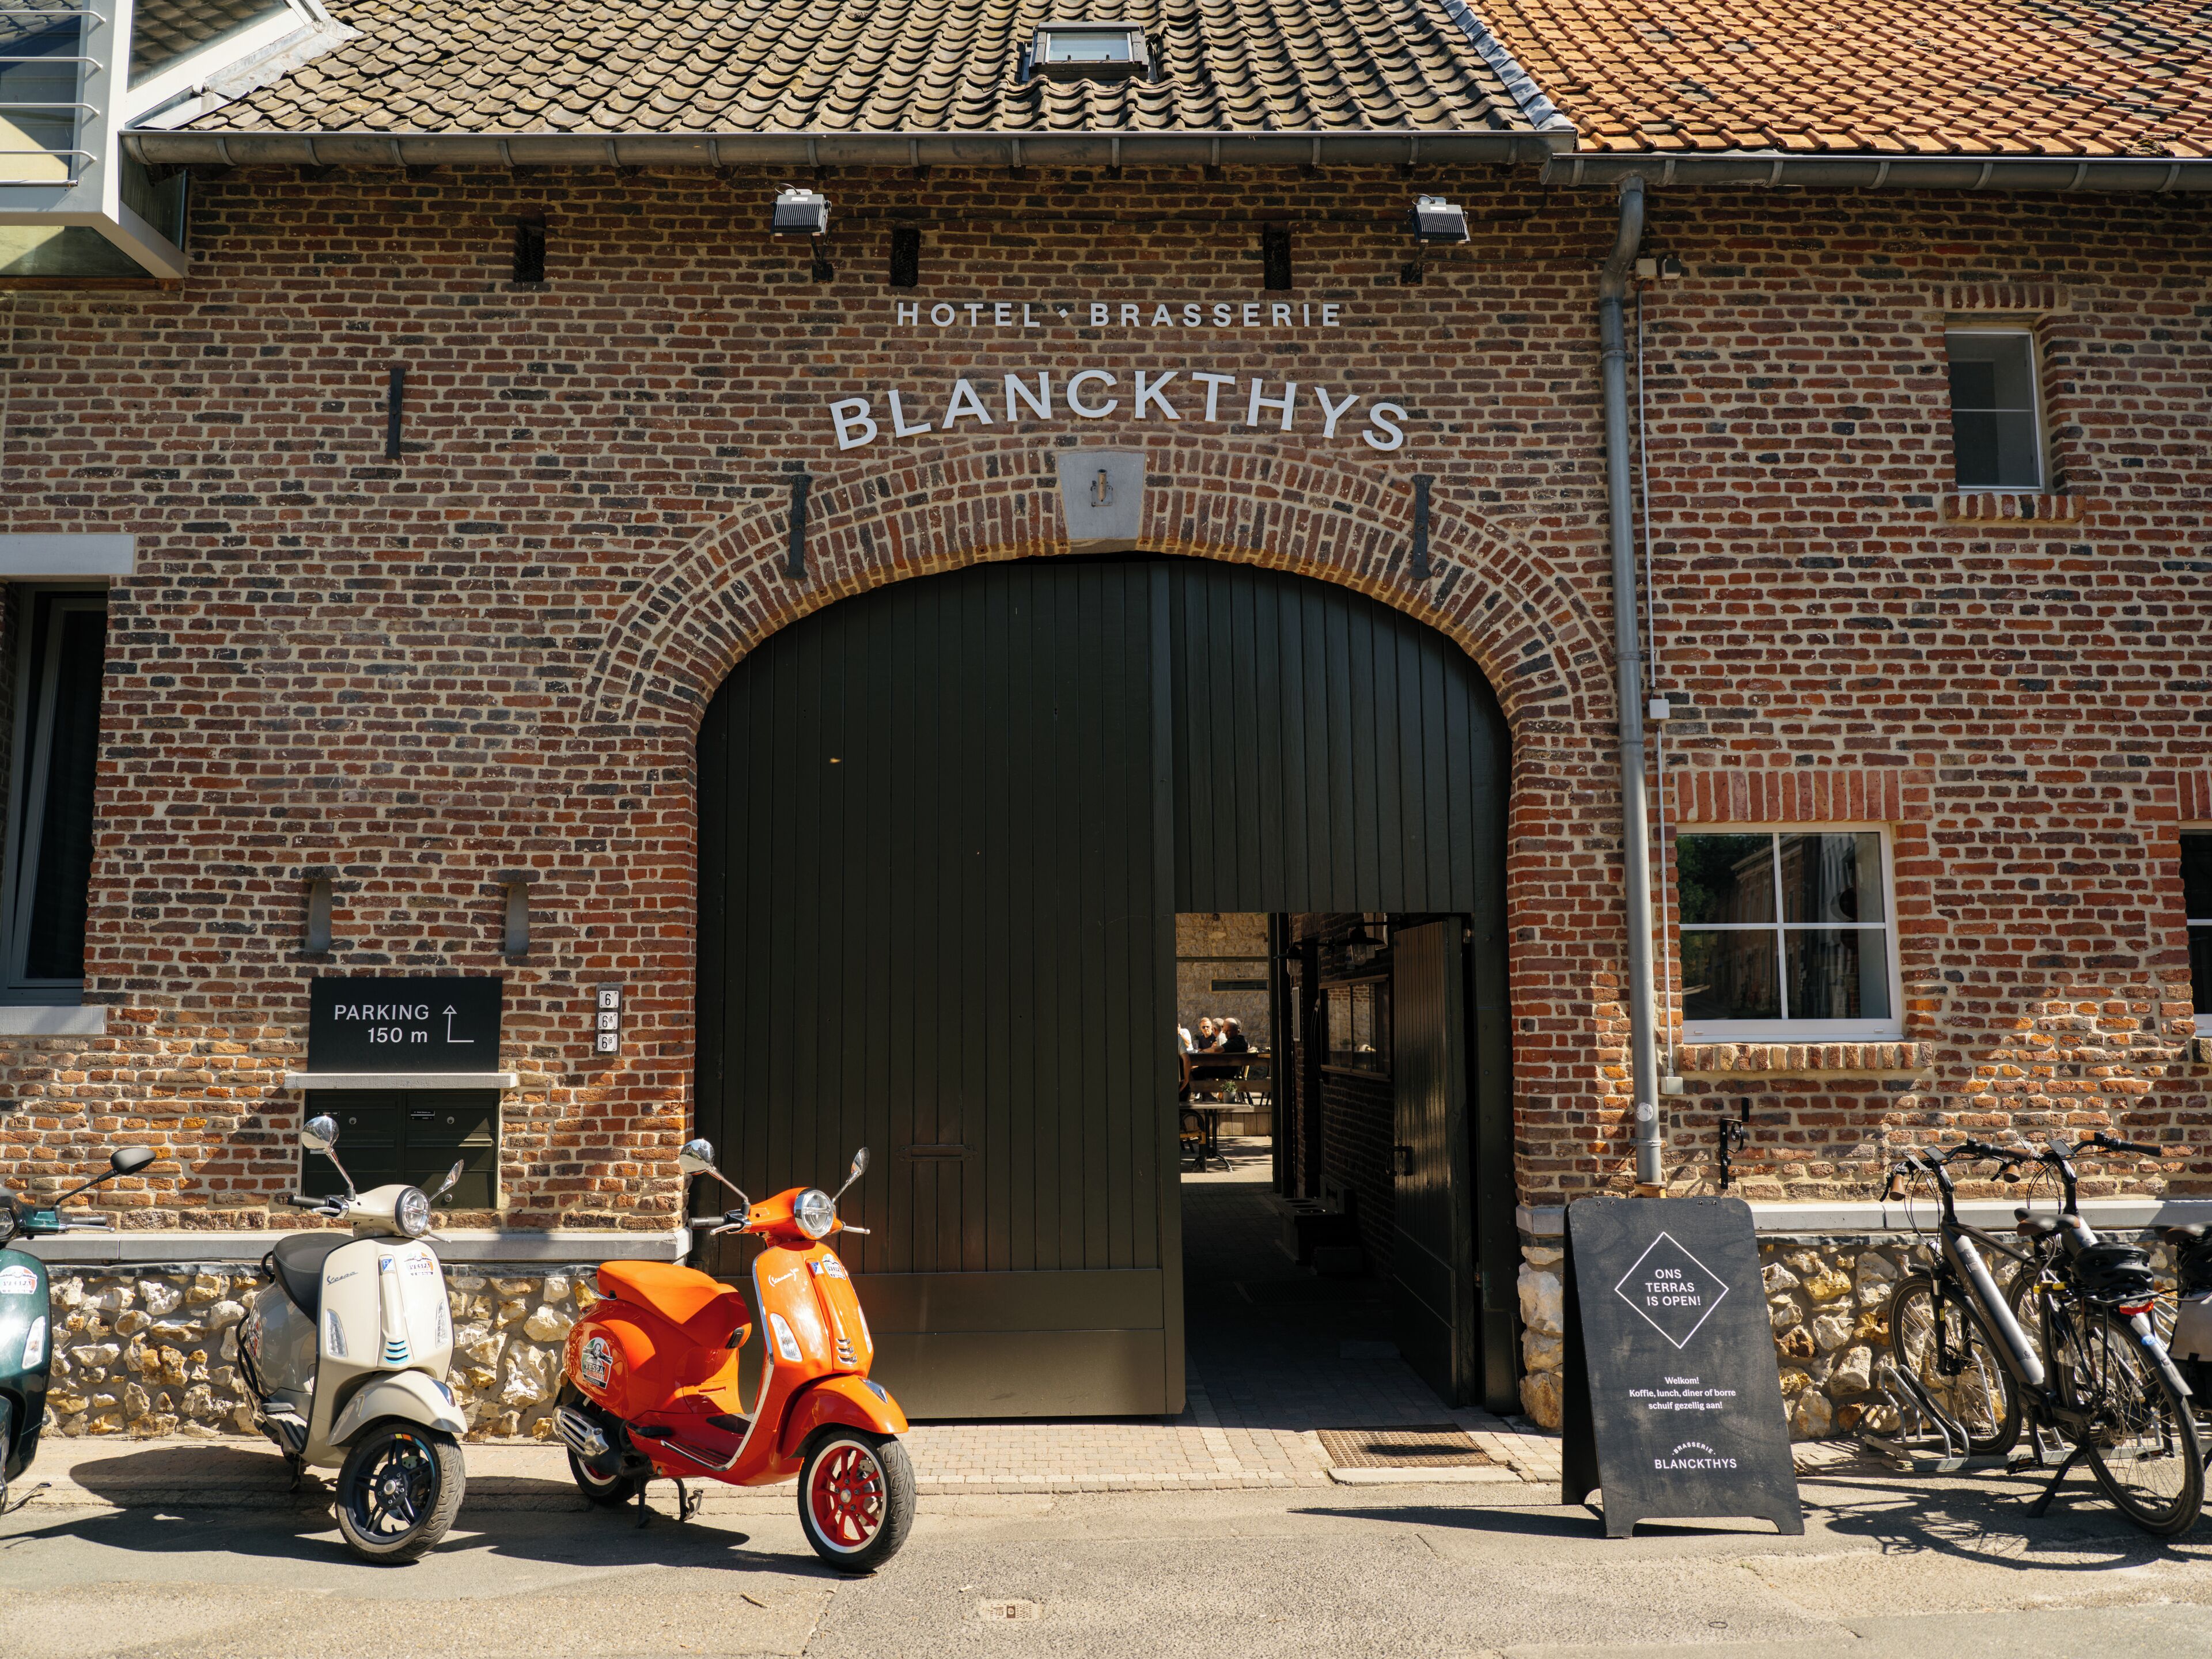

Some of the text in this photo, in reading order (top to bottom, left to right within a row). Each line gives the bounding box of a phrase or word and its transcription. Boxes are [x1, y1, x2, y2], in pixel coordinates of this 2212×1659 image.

[897, 302, 1340, 327] HOTEL BRASSERIE
[829, 370, 1408, 451] BLANCKTHYS
[605, 993, 611, 1006] 6
[334, 1004, 429, 1020] PARKING
[368, 1027, 427, 1043] 150 m
[1654, 1268, 1682, 1279] ONS
[1645, 1282, 1695, 1293] TERRAS
[1646, 1296, 1701, 1306] IS OPEN!
[585, 1361, 604, 1374] VESPA
[1664, 1376, 1700, 1385] Welkom!
[1628, 1388, 1736, 1398] Koffie, lunch, diner of borre
[1648, 1401, 1723, 1411] schuif gezellig aan!
[1673, 1441, 1714, 1455] BRASSERIE
[1654, 1458, 1737, 1469] BLANCKTHYS
